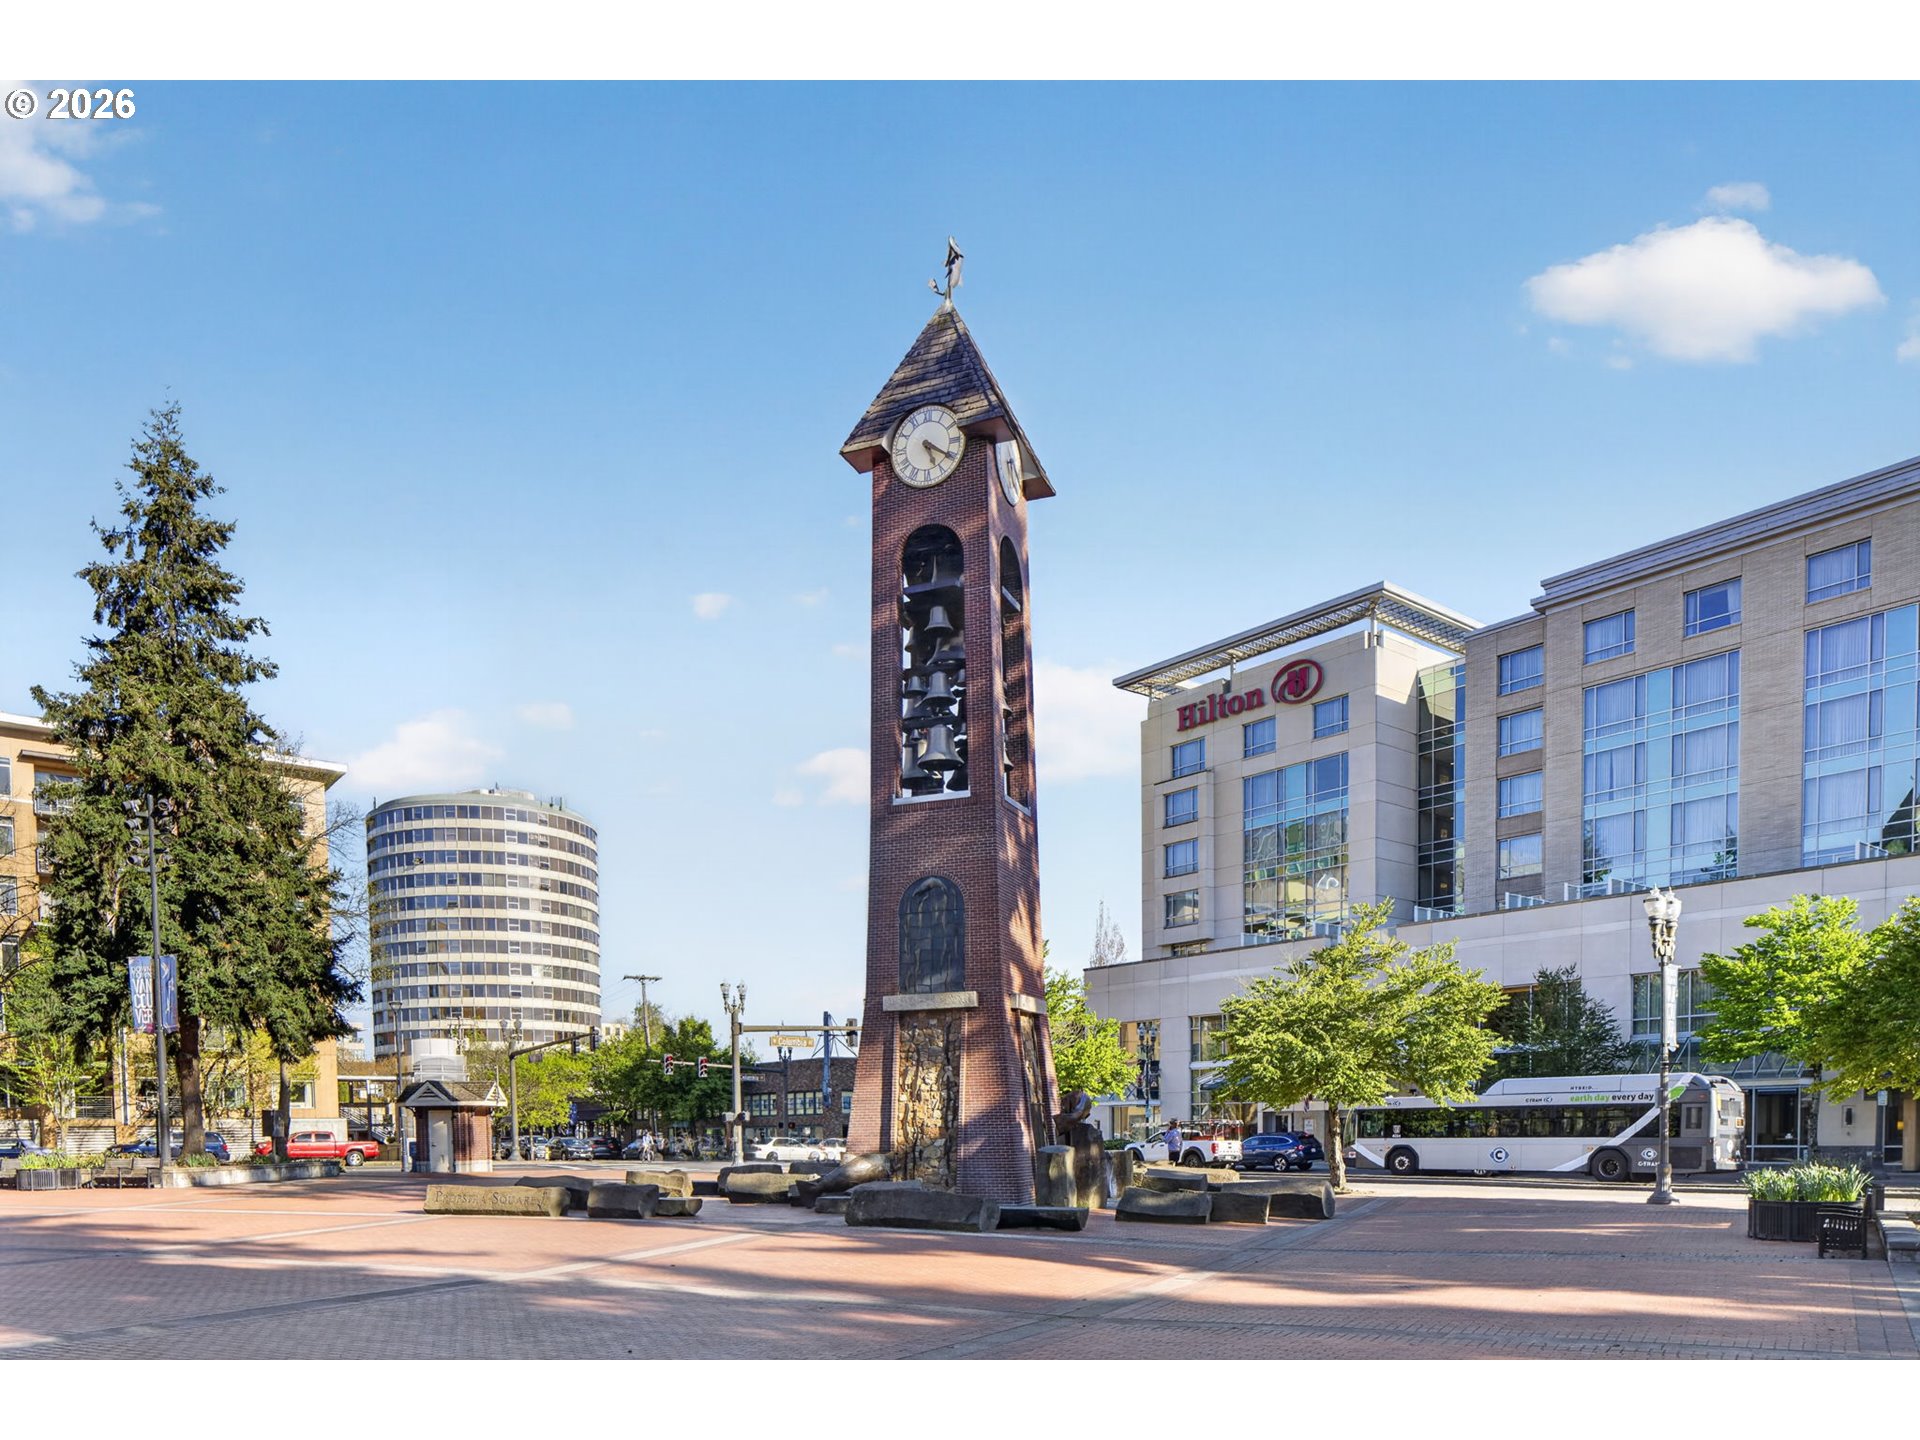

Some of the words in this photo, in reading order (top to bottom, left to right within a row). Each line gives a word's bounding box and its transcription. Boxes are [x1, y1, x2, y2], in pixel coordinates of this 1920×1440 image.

[1177, 688, 1265, 731] Hilton
[1569, 1094, 1593, 1102] earth
[1595, 1093, 1610, 1102] day
[1612, 1094, 1636, 1102] every
[1637, 1092, 1654, 1101] day
